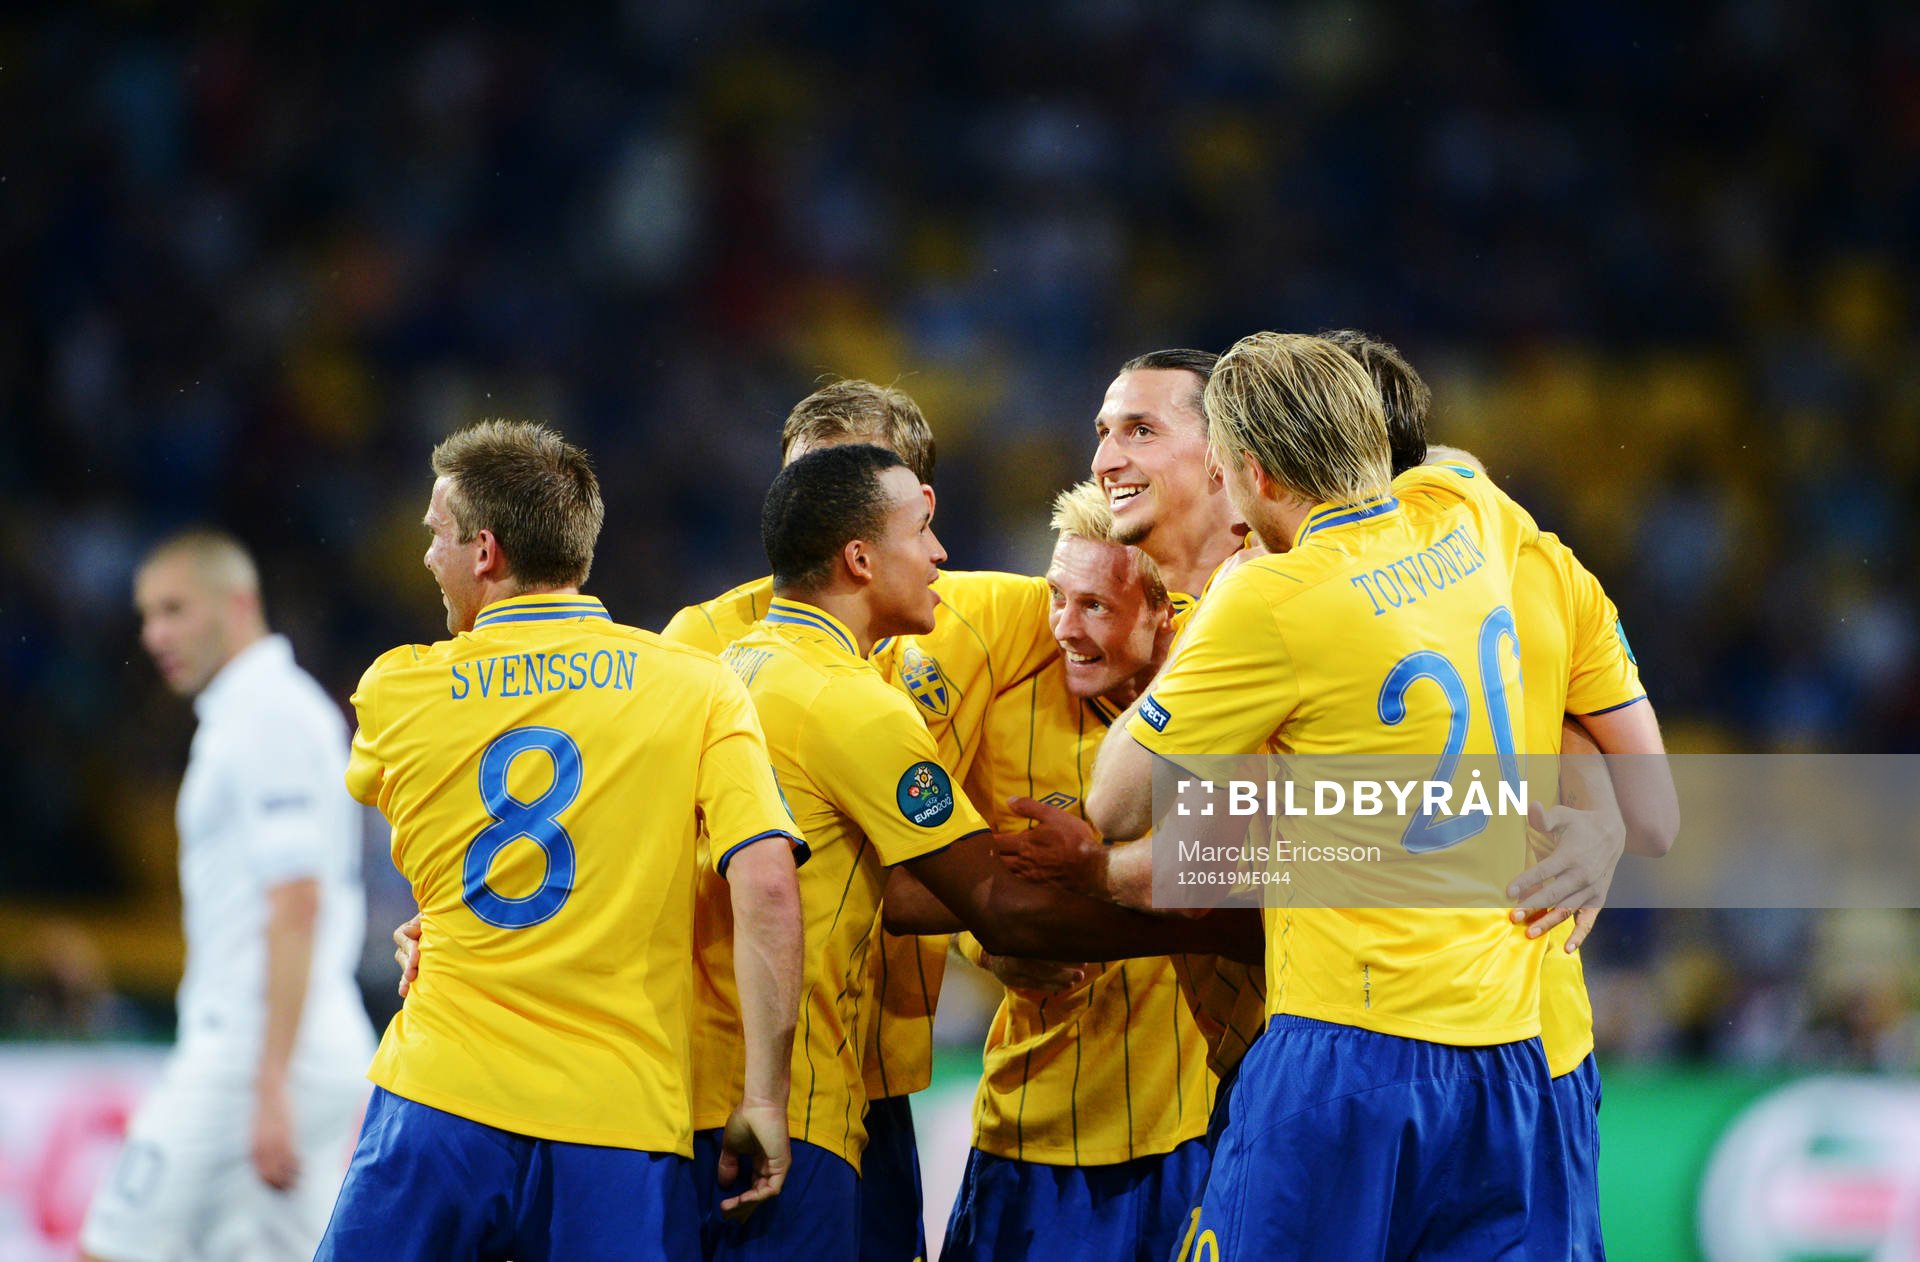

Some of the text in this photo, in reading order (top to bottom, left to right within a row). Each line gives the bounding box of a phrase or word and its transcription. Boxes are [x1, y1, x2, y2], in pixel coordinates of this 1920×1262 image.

[1350, 524, 1487, 616] TOIVONEN
[451, 649, 637, 700] SVENSSON
[1377, 605, 1528, 855] 20
[461, 725, 584, 930] 8
